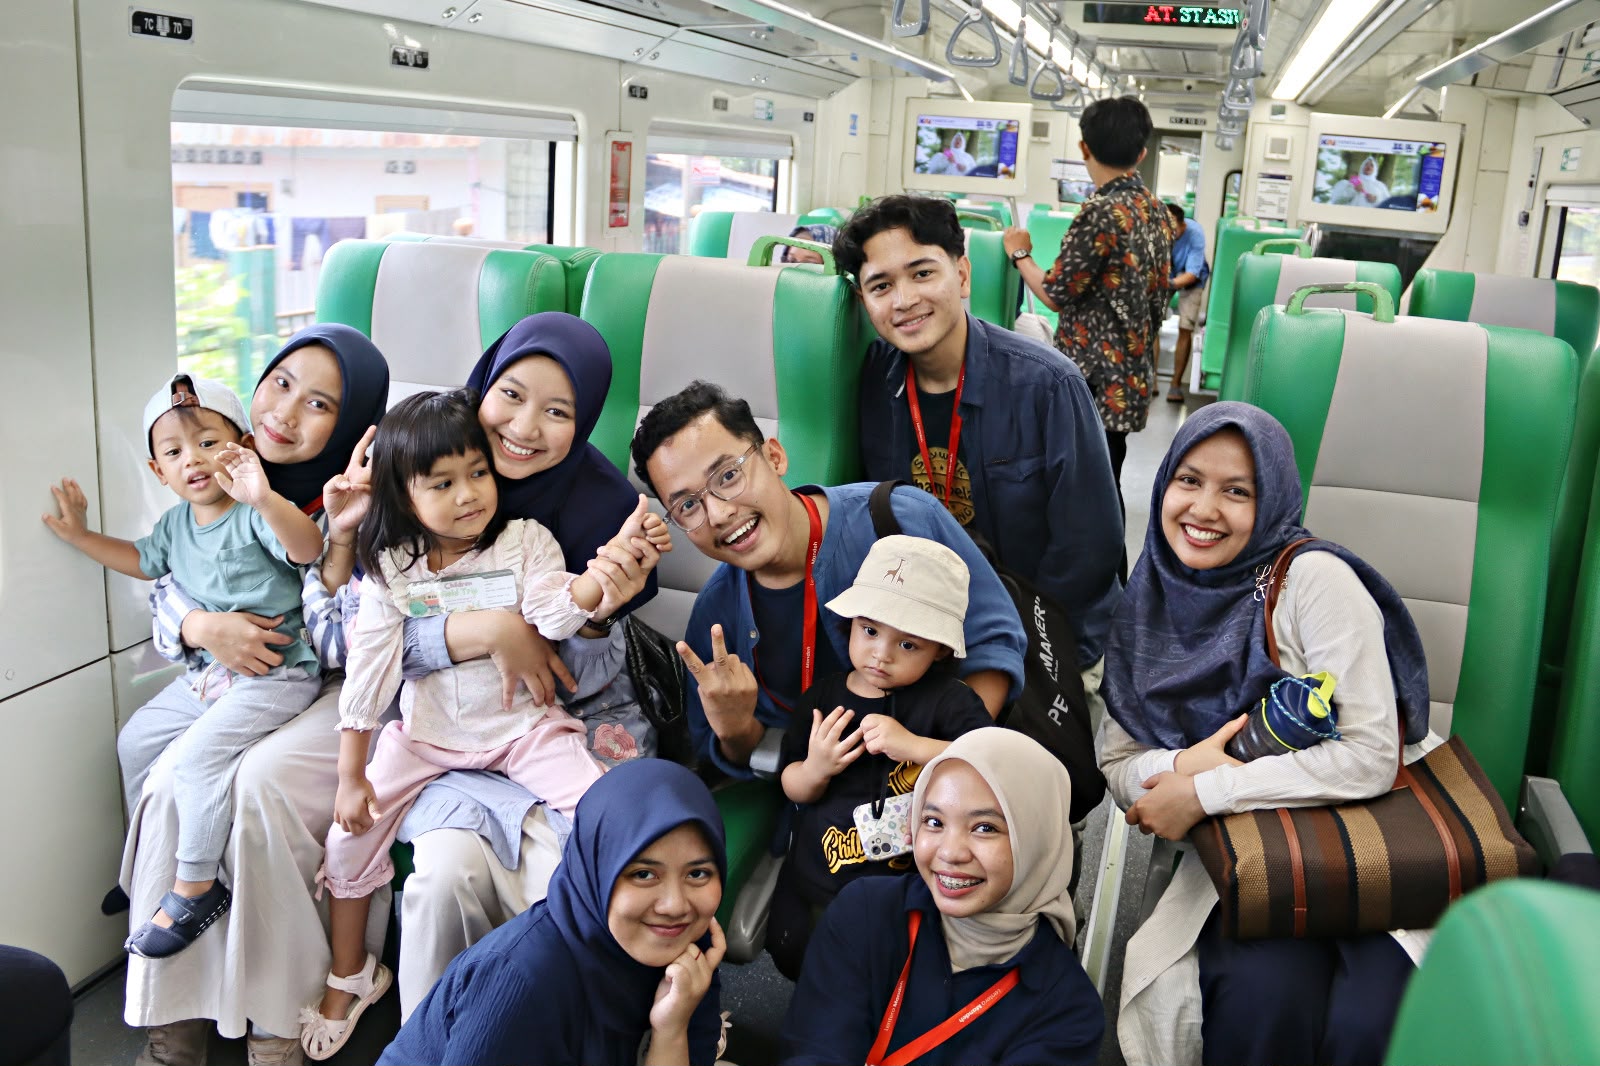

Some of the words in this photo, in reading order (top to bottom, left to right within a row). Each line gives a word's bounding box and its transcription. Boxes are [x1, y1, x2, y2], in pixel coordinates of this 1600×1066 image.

[1143, 5, 1178, 23] AT.
[144, 17, 154, 31] 7C
[173, 22, 183, 34] 7D
